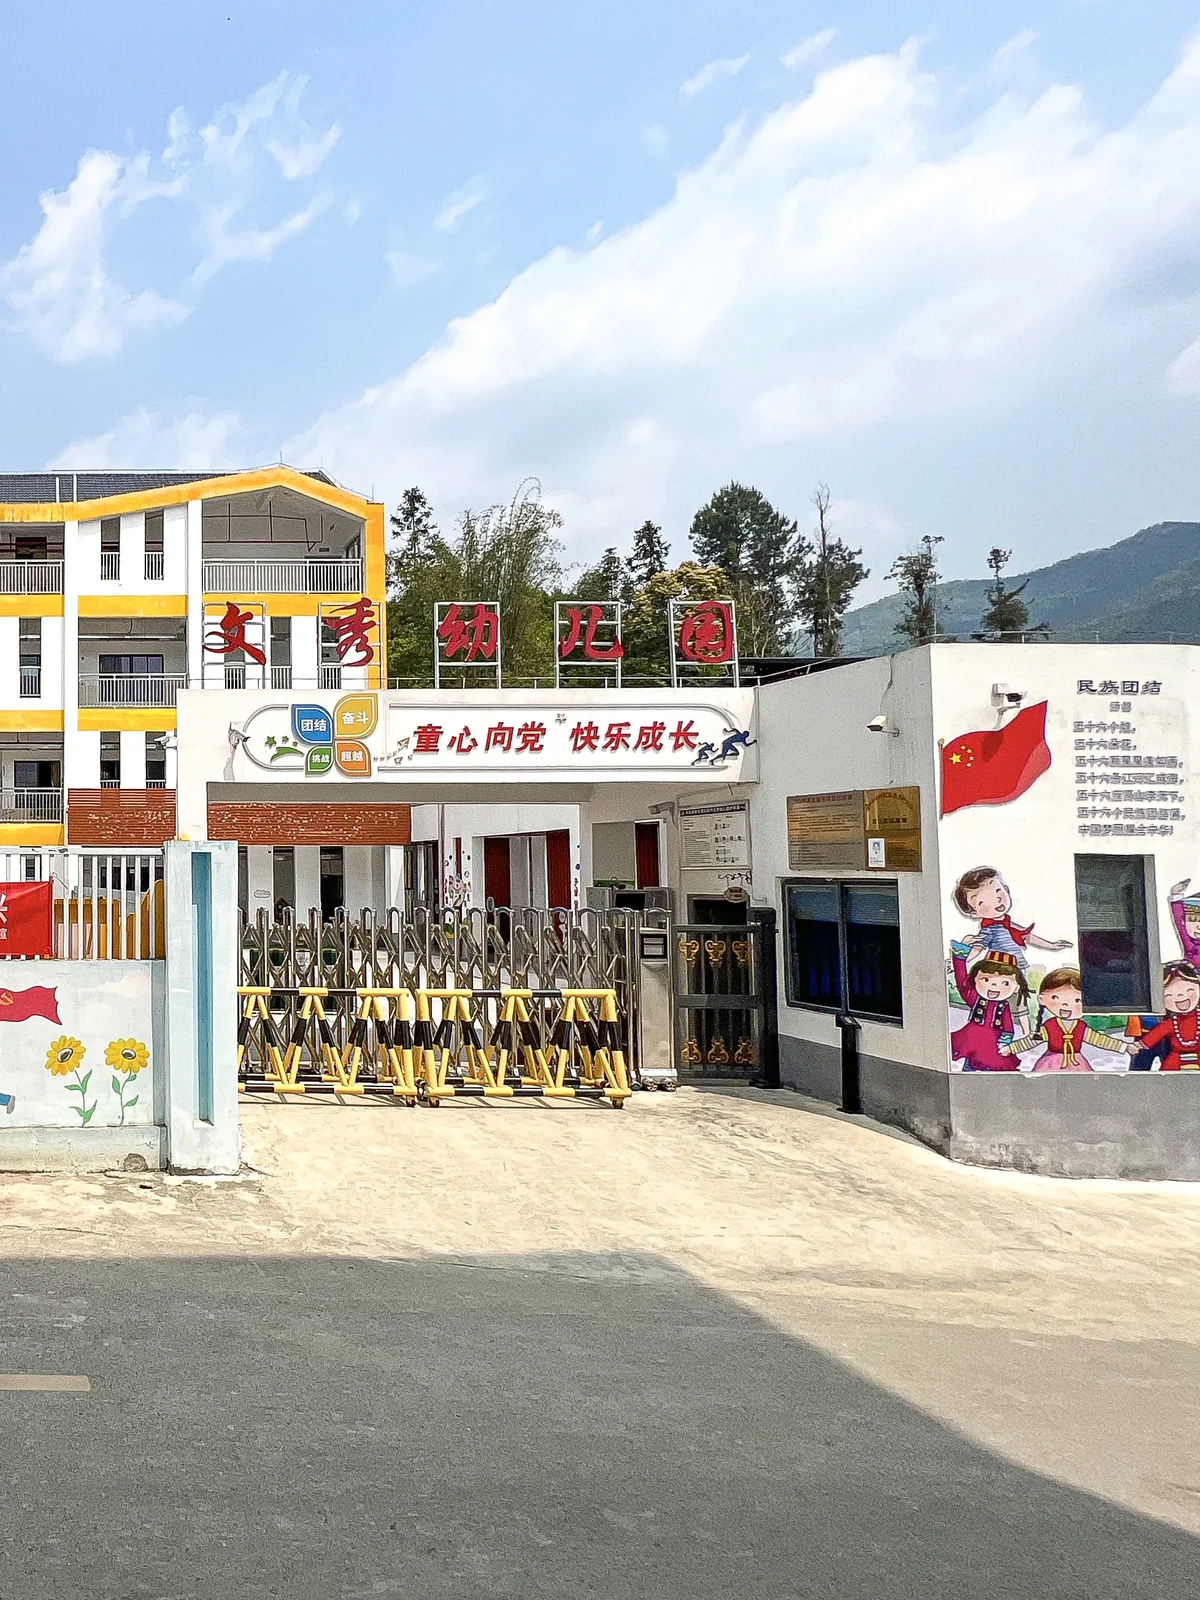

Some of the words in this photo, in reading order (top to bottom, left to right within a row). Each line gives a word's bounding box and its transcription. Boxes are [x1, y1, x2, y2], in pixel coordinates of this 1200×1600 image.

[203, 597, 734, 667] 文秀幼儿园
[1077, 680, 1162, 695] 民族团结
[301, 718, 328, 732] 团结
[342, 712, 369, 726] 奋斗
[412, 720, 546, 753] 童心向党
[570, 720, 699, 751] 快乐成长
[311, 753, 330, 764] 挑战
[341, 750, 363, 763] 超越
[0, 928, 8, 941] 宣
